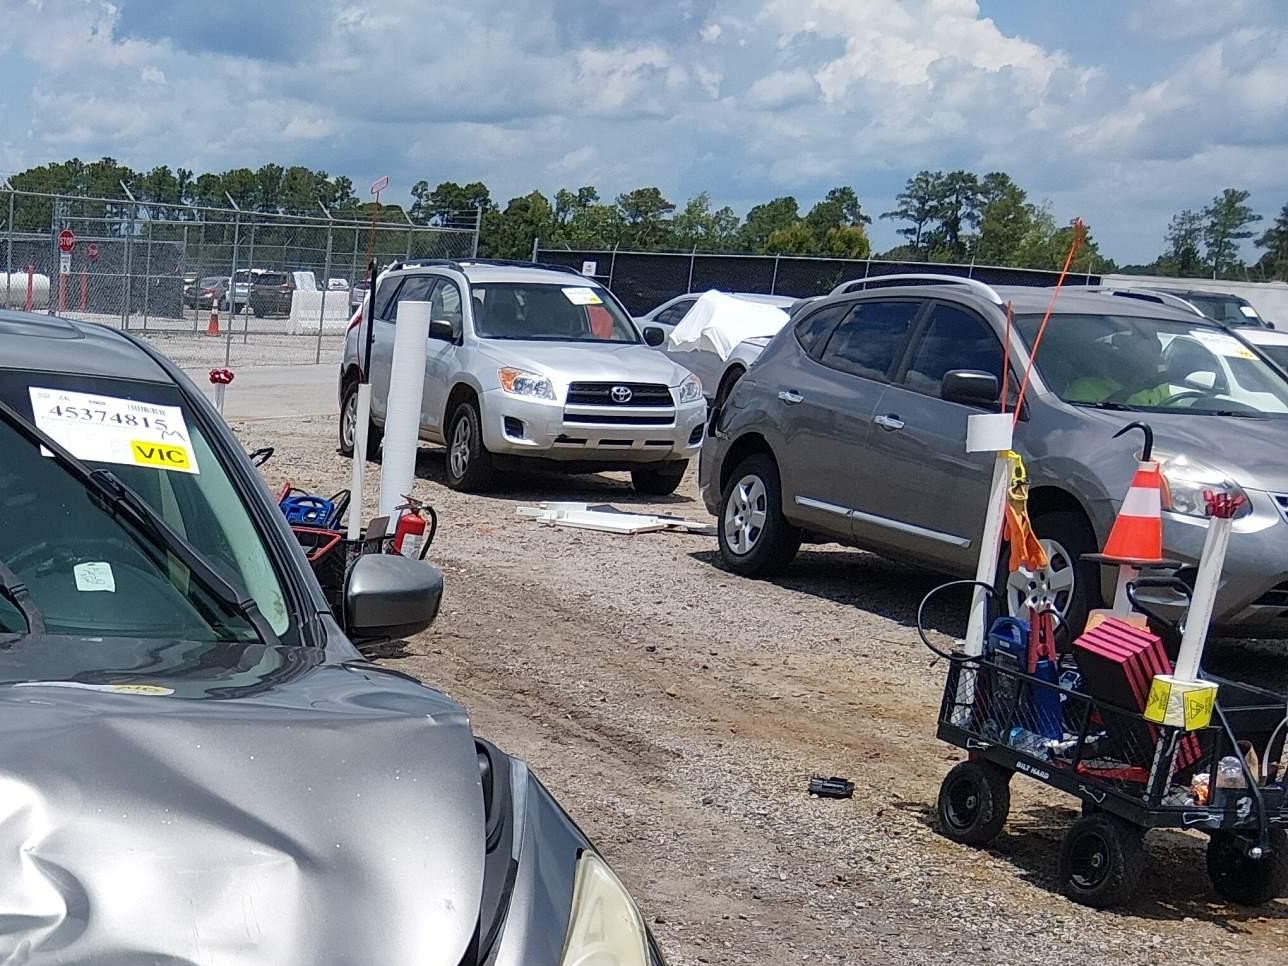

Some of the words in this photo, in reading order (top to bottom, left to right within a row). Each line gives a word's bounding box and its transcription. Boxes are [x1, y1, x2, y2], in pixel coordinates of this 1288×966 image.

[59, 236, 73, 246] STOP
[49, 405, 168, 431] 45374815
[136, 445, 185, 464] VIC
[1030, 767, 1050, 780] HARD
